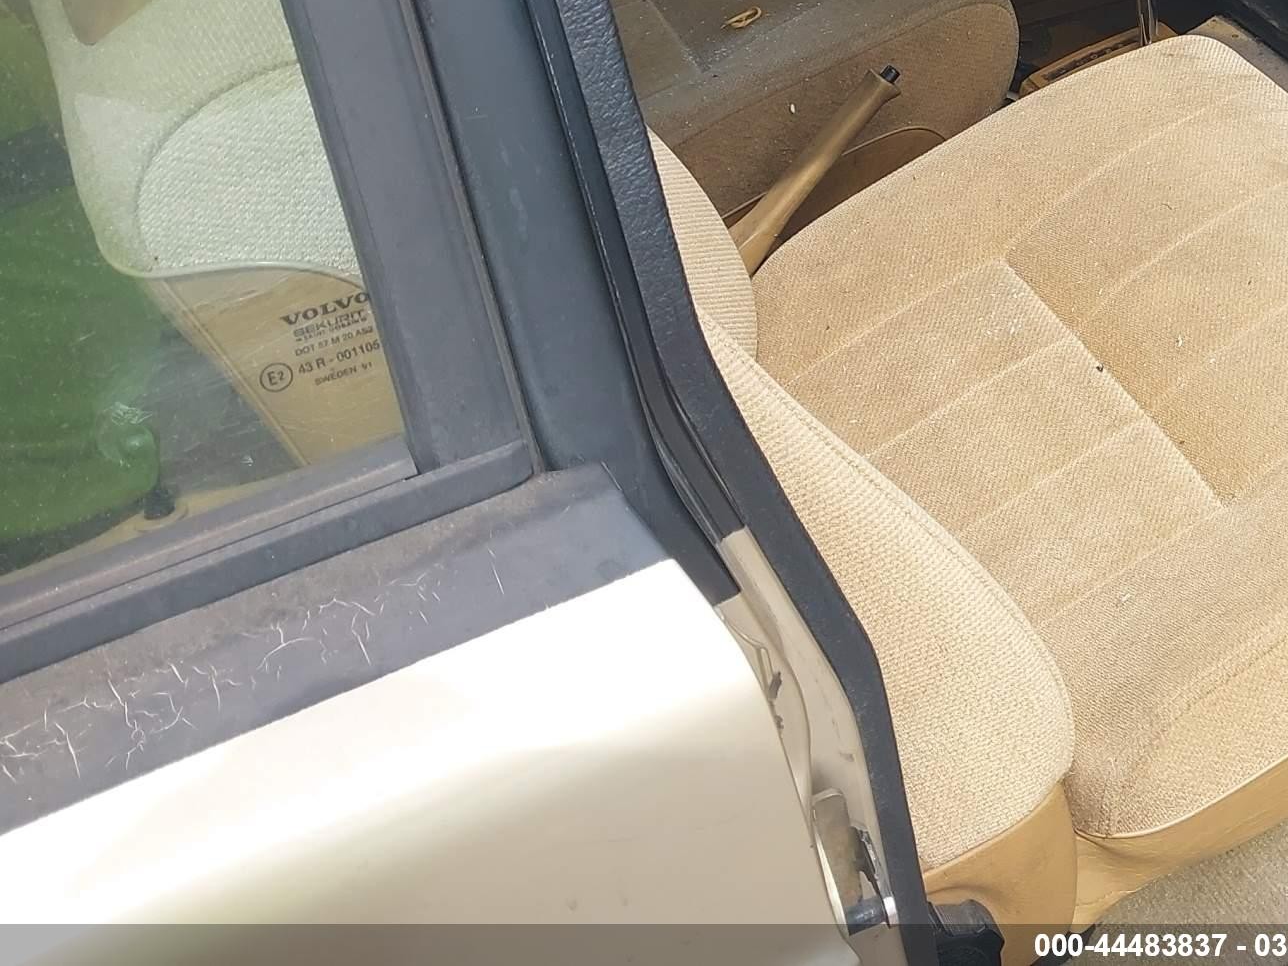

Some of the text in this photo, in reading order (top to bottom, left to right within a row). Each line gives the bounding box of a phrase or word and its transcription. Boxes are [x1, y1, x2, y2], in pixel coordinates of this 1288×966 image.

[280, 291, 370, 325] VOLVO
[294, 343, 315, 357] DOT
[298, 361, 314, 375] 43
[315, 357, 326, 369] R
[336, 338, 380, 363] 001105
[267, 370, 285, 386] E2
